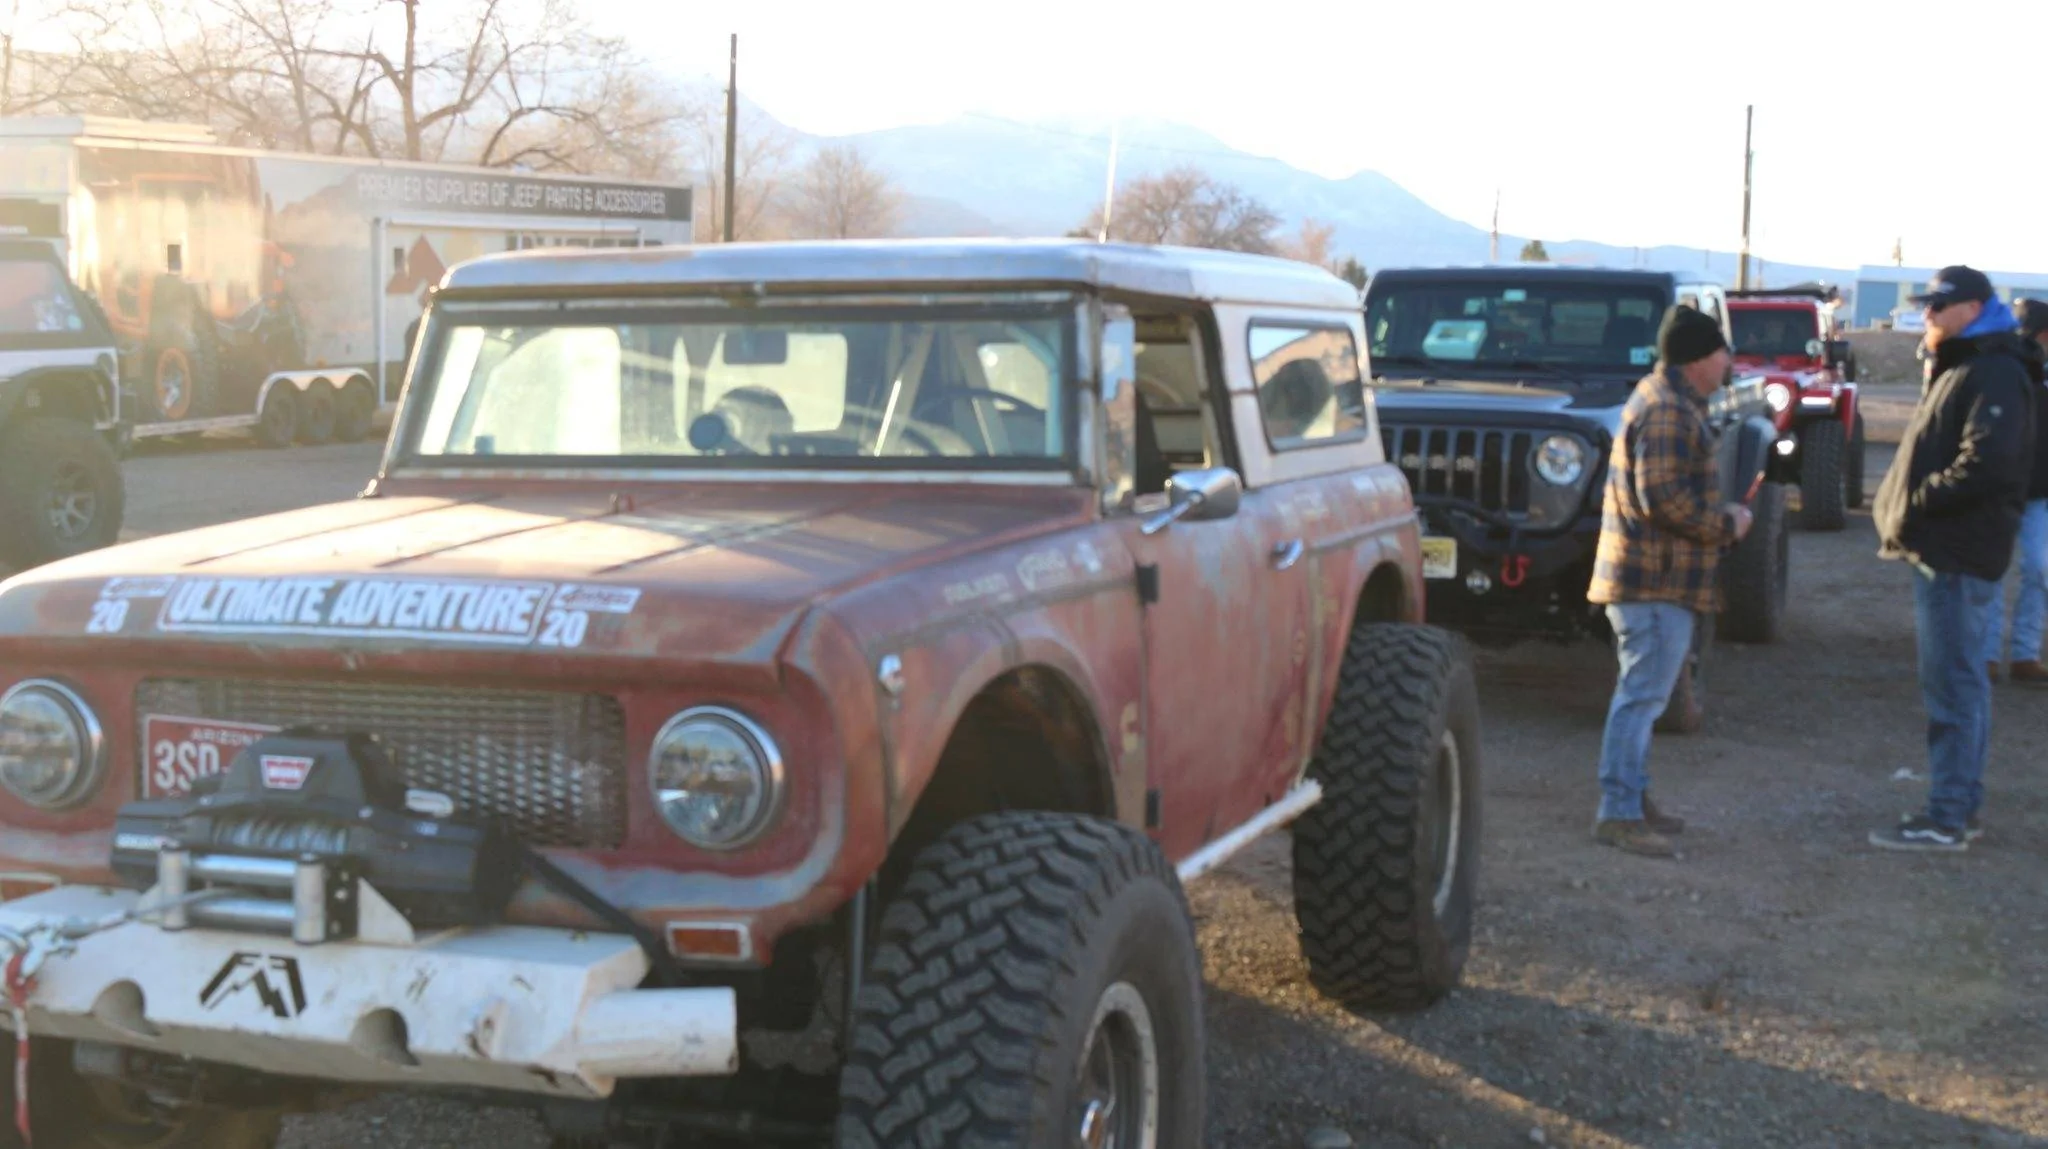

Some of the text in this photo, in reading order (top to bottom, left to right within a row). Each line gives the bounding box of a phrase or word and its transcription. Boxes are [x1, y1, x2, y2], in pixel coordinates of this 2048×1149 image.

[357, 172, 422, 202] PREMIER
[425, 177, 489, 206] SUPPLIER
[491, 182, 510, 207] OF
[545, 185, 583, 211] PARTS
[584, 189, 593, 211] &
[593, 187, 667, 215] ACCESSORIES
[86, 600, 130, 634] 20
[168, 577, 337, 624] ULTIMATE
[328, 580, 544, 633] ADVENTURE
[538, 609, 589, 648] 20
